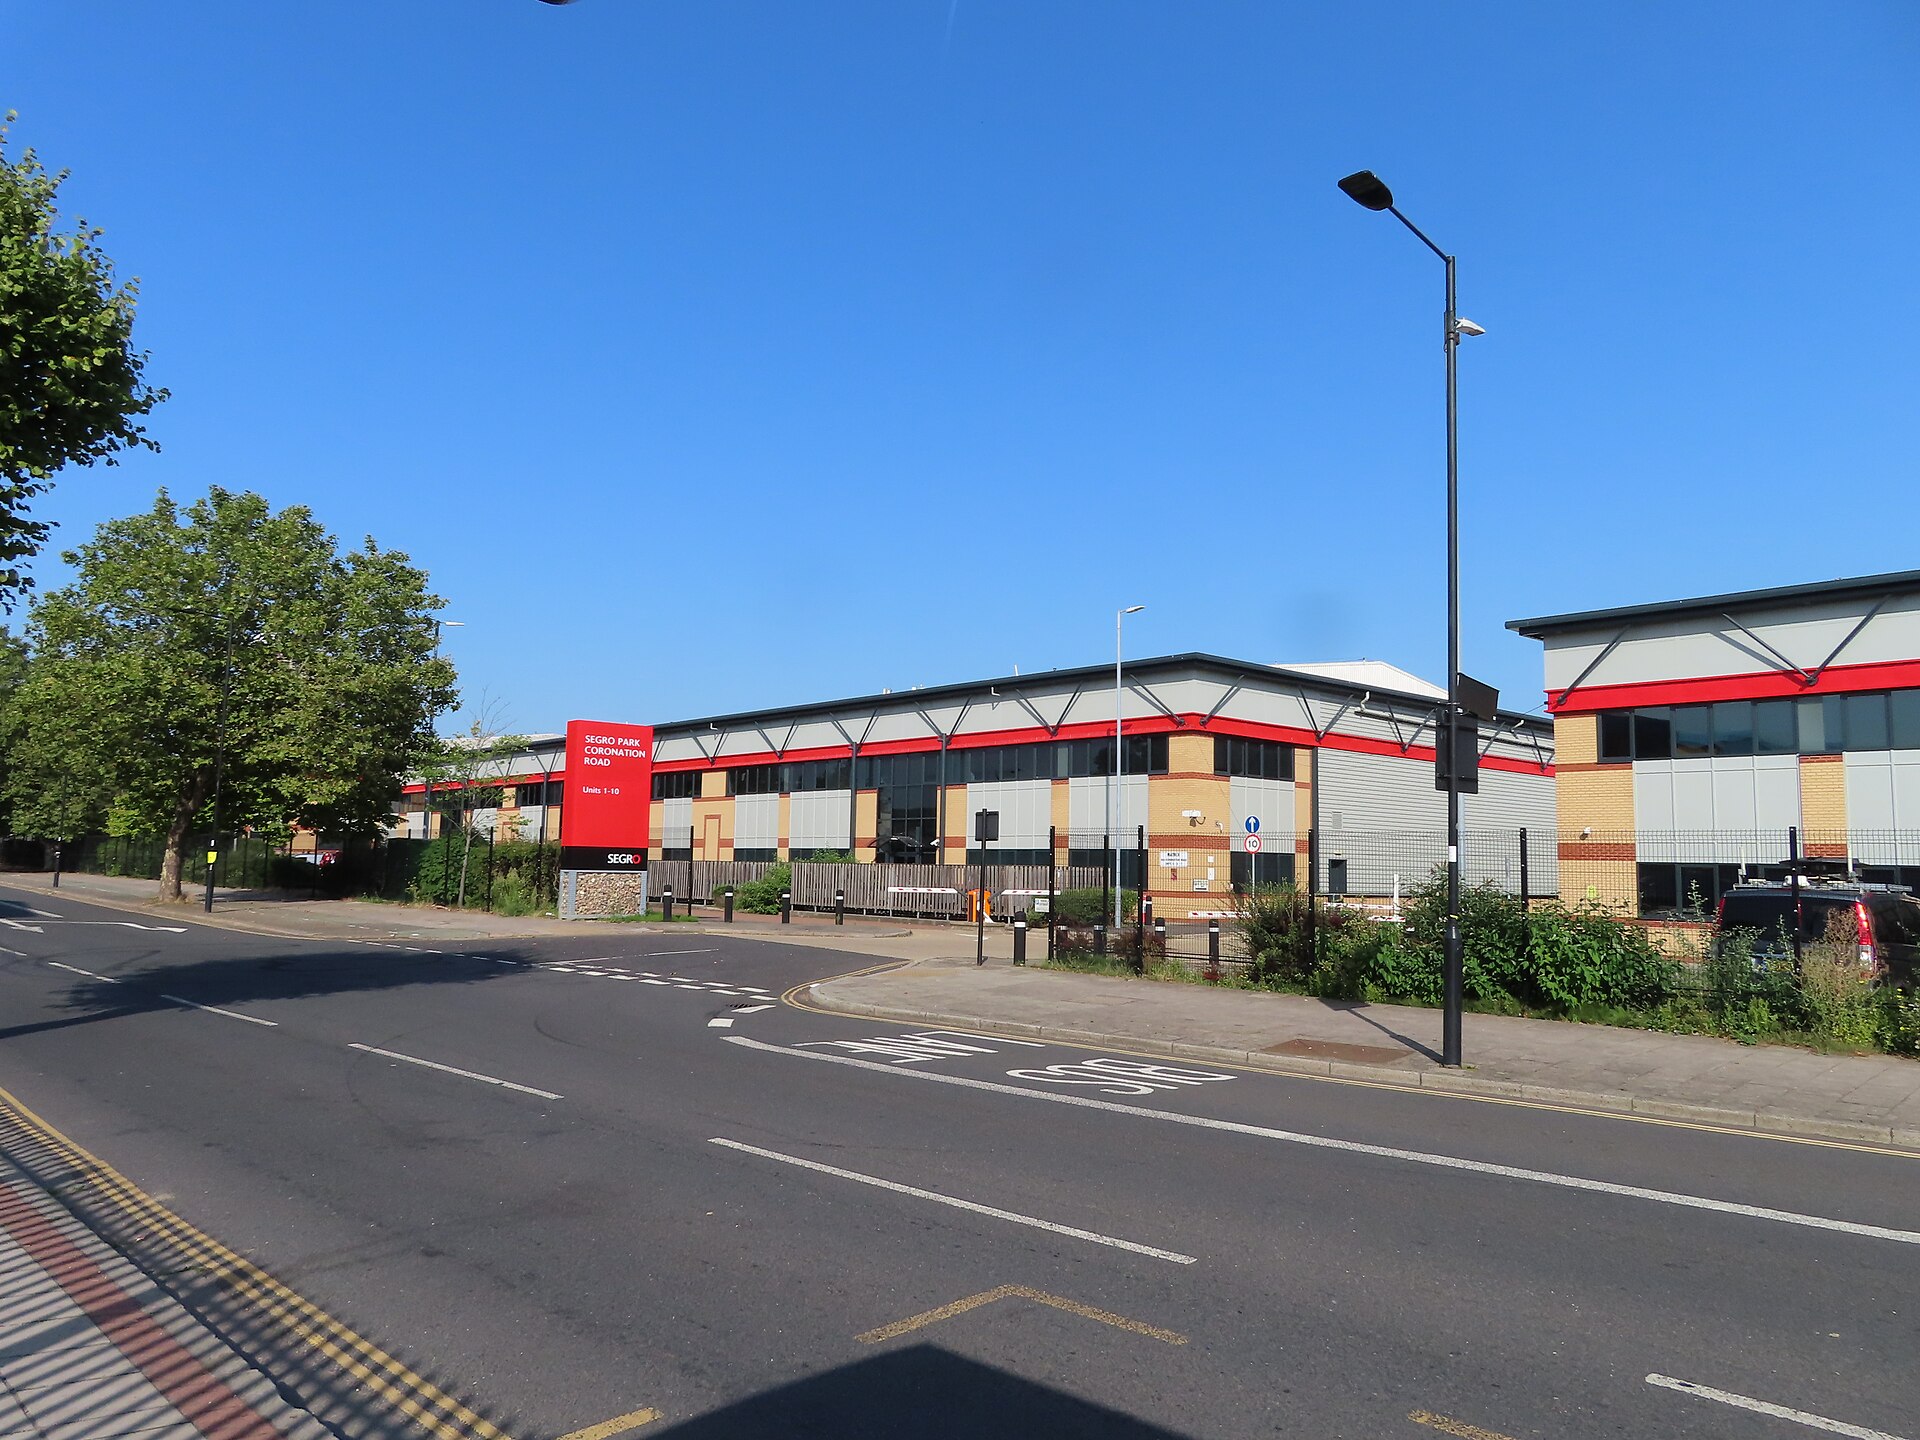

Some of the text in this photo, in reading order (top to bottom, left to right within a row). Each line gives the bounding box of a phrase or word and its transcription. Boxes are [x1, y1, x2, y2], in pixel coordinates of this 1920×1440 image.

[585, 734, 641, 747] SEGRO PARK
[584, 745, 646, 758] CORONATION
[584, 757, 611, 766] ROAD
[582, 786, 602, 794] Units
[1248, 840, 1258, 848] 10
[607, 854, 641, 864] SEGRO
[791, 1030, 1046, 1064] LANE
[1005, 1057, 1238, 1096] BUS
